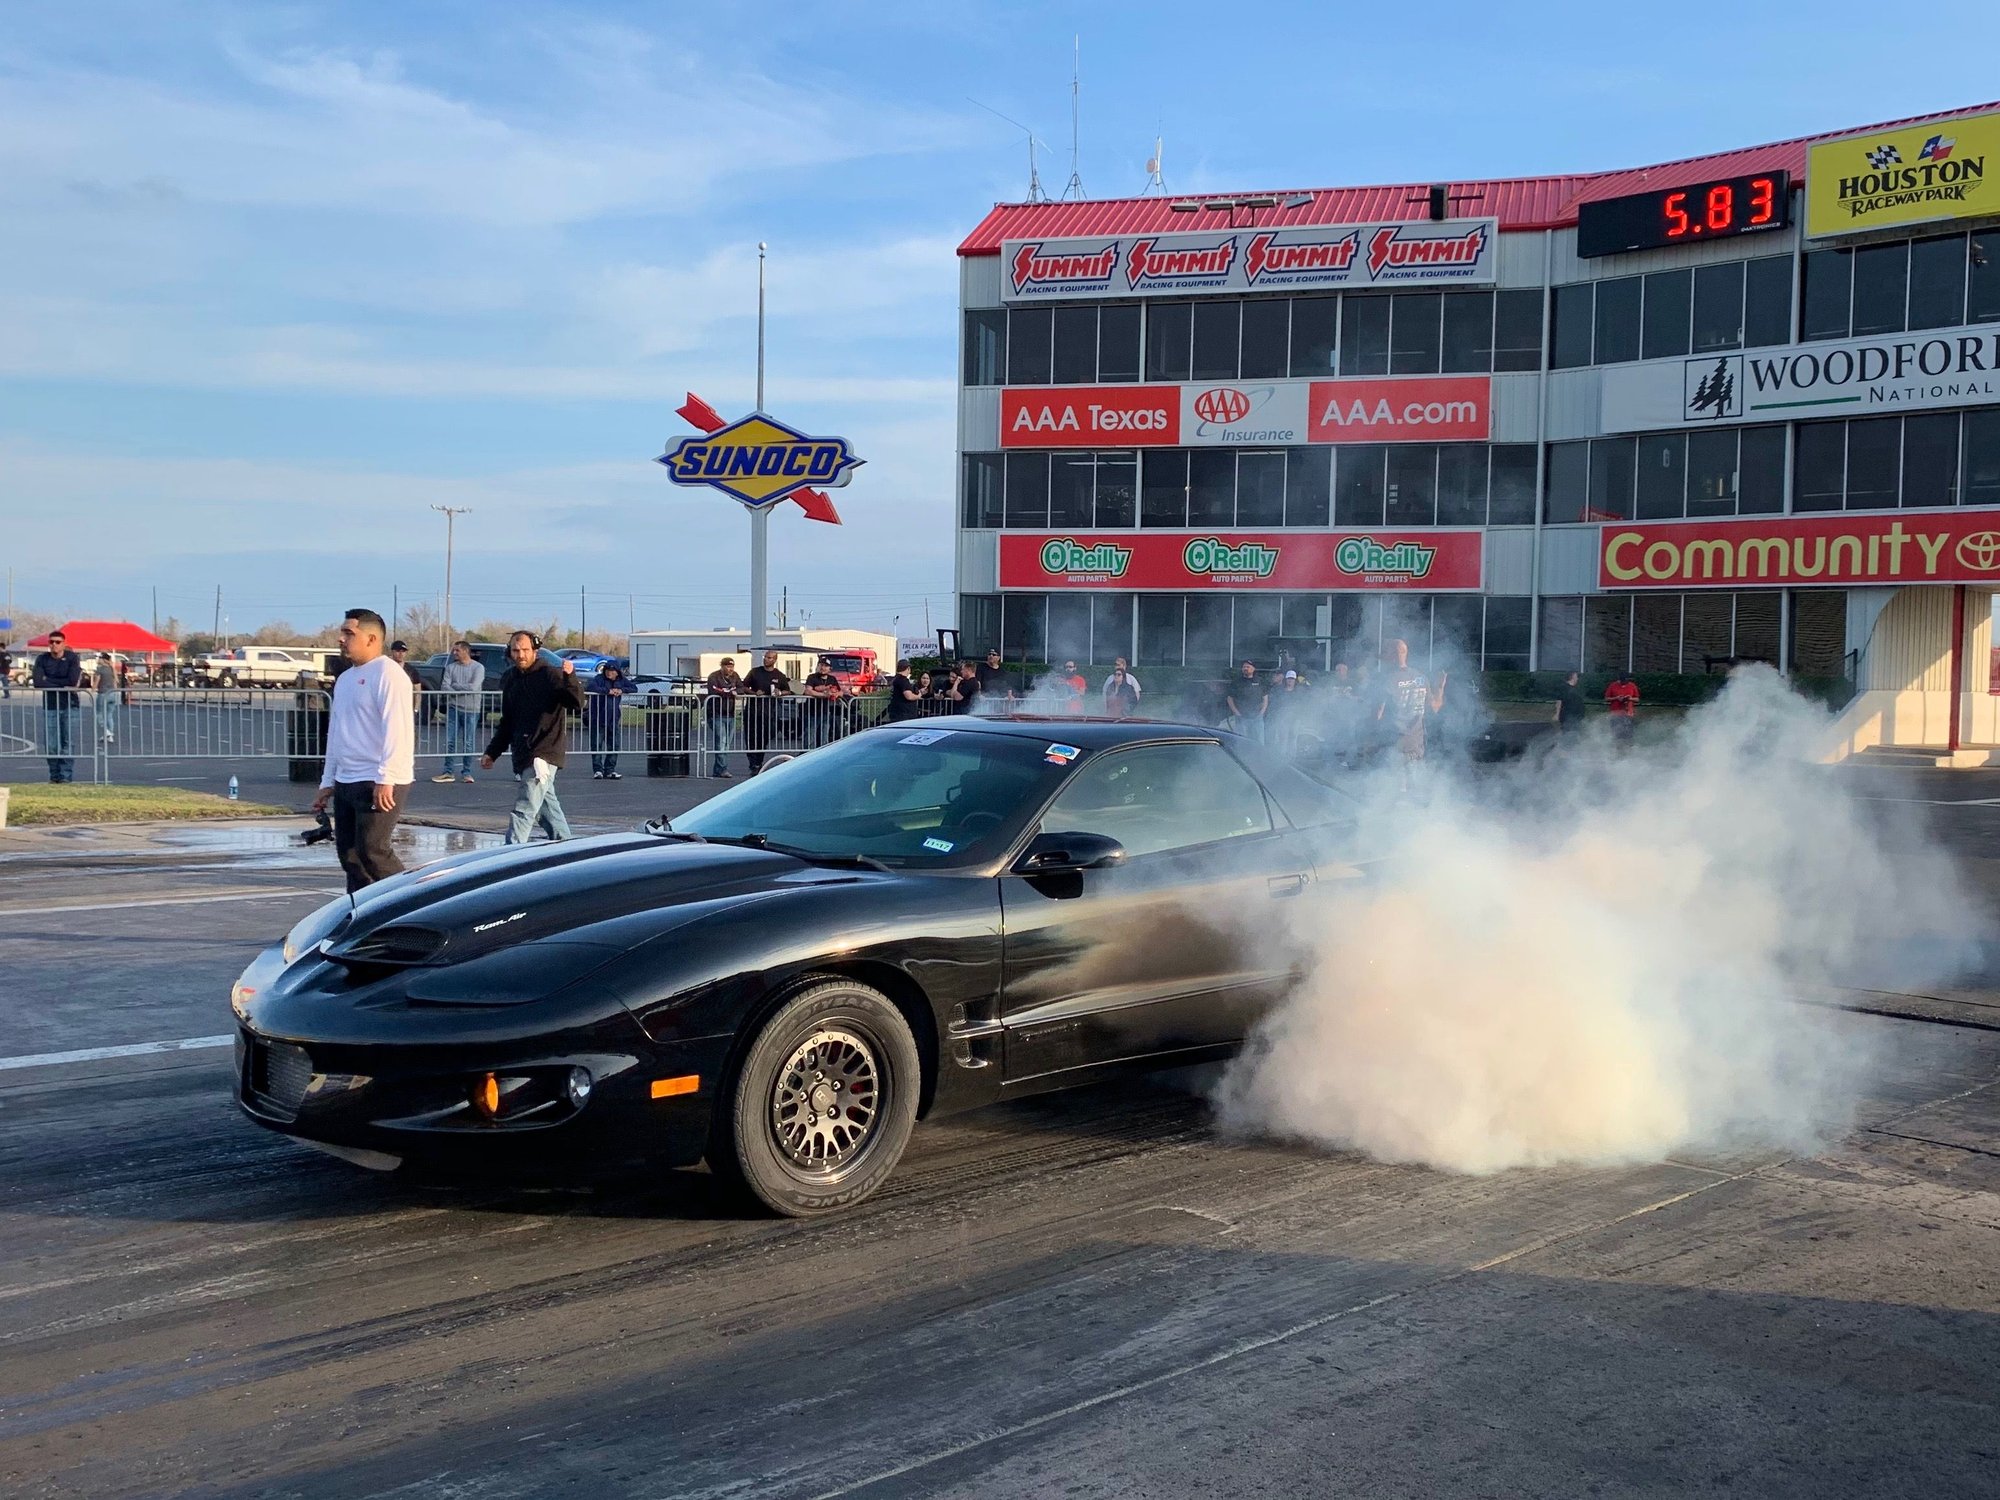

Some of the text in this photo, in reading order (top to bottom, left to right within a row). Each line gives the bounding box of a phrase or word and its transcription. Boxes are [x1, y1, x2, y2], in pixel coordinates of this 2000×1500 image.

[1838, 155, 1985, 200] HOUSTON
[1664, 177, 1774, 238] 5.83
[1851, 184, 1967, 218] RACEWAY PARK
[1025, 283, 1110, 294] RACING EQUIPMENT
[1140, 279, 1227, 289] RACING EQUIPMENT
[1258, 273, 1349, 284] RACING EQUIPMENT
[1382, 269, 1476, 279] RACING EQUIPMENT
[1199, 391, 1248, 423] AAA
[1869, 381, 1994, 404] NATIONAL
[1012, 403, 1167, 432] AAA Texas
[1320, 398, 1476, 427] AAA.com
[1221, 427, 1294, 442] Insurance
[677, 445, 839, 477] SUNOCO
[1043, 540, 1129, 574] O'Reilly
[1187, 540, 1275, 574] O'Reilly
[1338, 540, 1431, 574] O'Reilly
[1605, 521, 1951, 581] Community
[1067, 575, 1085, 583] AUTO
[1211, 575, 1230, 583] AUTO
[1364, 575, 1409, 583] AUTO PARTS
[920, 642, 938, 650] PARTS
